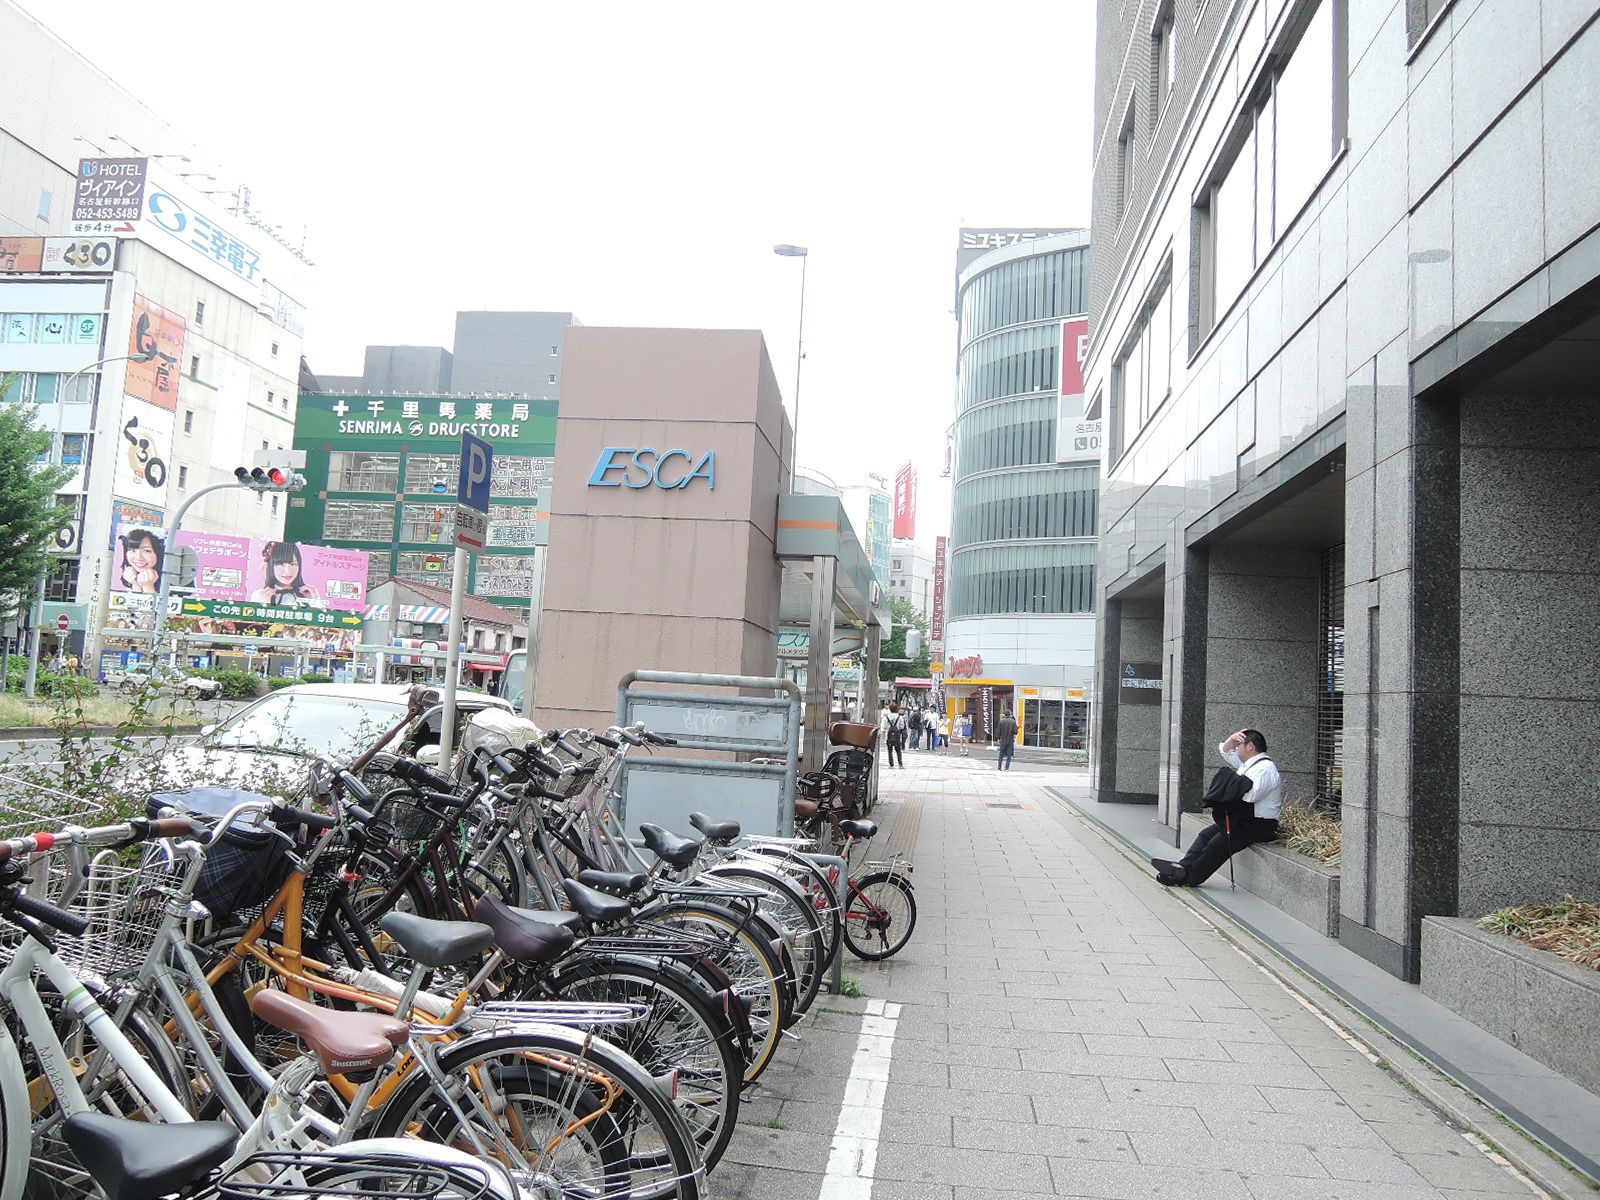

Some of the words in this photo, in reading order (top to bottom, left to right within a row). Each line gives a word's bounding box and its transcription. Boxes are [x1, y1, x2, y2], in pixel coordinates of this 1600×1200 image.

[100, 164, 142, 176] HOTEL
[80, 179, 141, 197] ヴィアイン
[76, 207, 138, 219] 052-453-5489
[191, 215, 260, 280] 三幸電子
[367, 400, 529, 421] 千里馬薬局
[339, 420, 403, 434] SENRIMA
[429, 422, 520, 438] DRUGSTORE
[467, 442, 487, 499] P
[587, 447, 715, 491] ESCA
[212, 604, 241, 616] この先
[256, 607, 313, 621] 時間貸駐車場
[318, 613, 335, 623] 9台
